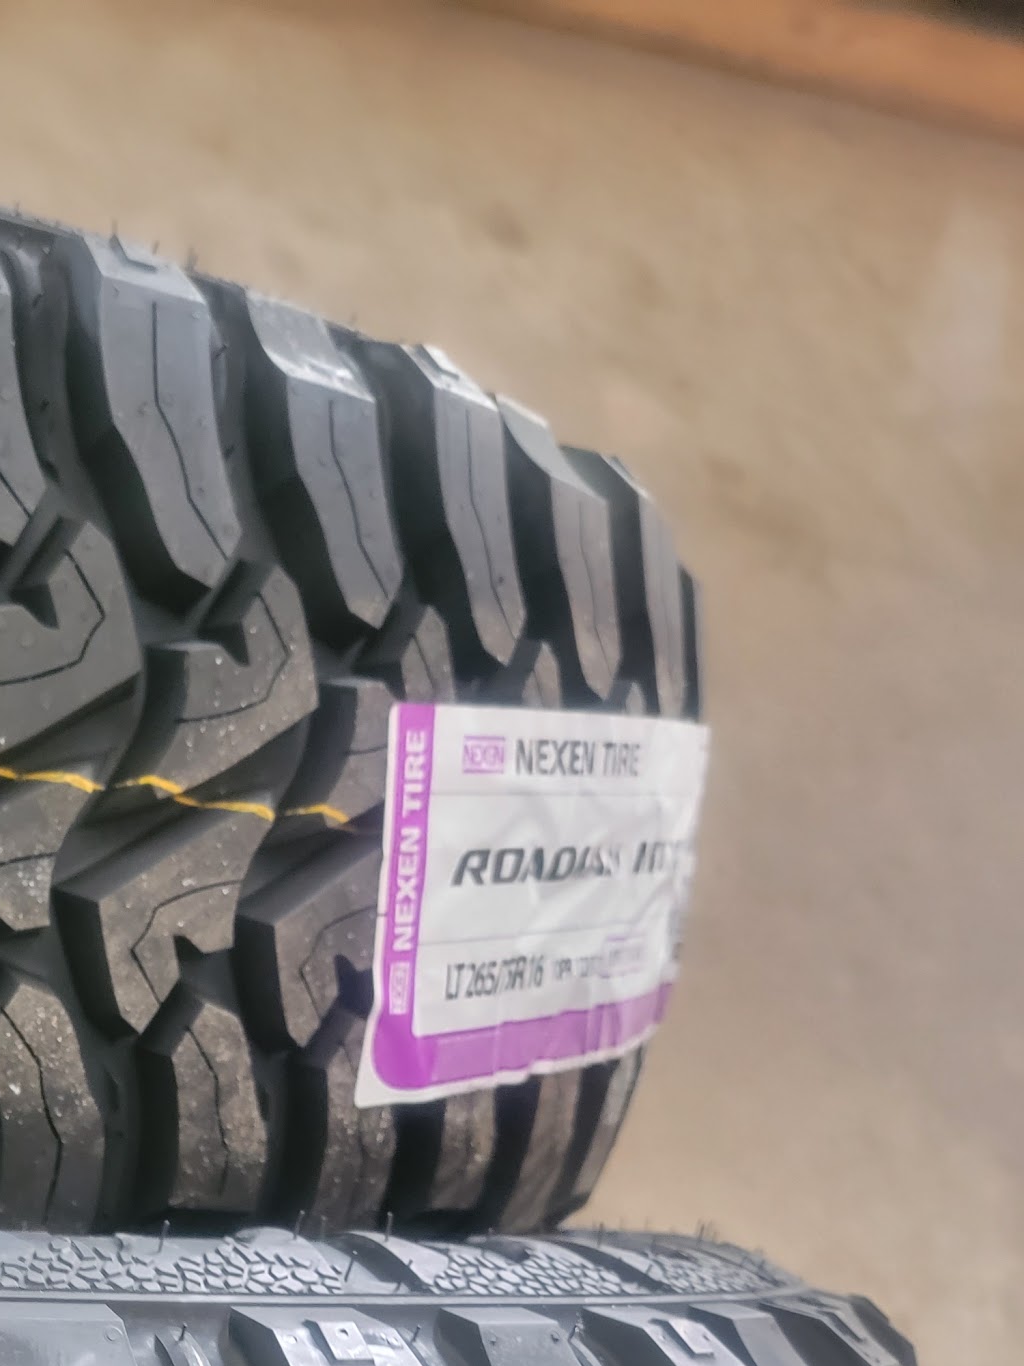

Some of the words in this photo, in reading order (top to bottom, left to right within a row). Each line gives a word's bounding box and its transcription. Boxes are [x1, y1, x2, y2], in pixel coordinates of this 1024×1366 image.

[402, 730, 427, 818] TIRE
[514, 738, 595, 776] NEXEN
[600, 743, 640, 776] TIRE
[392, 826, 421, 952] NEXEN
